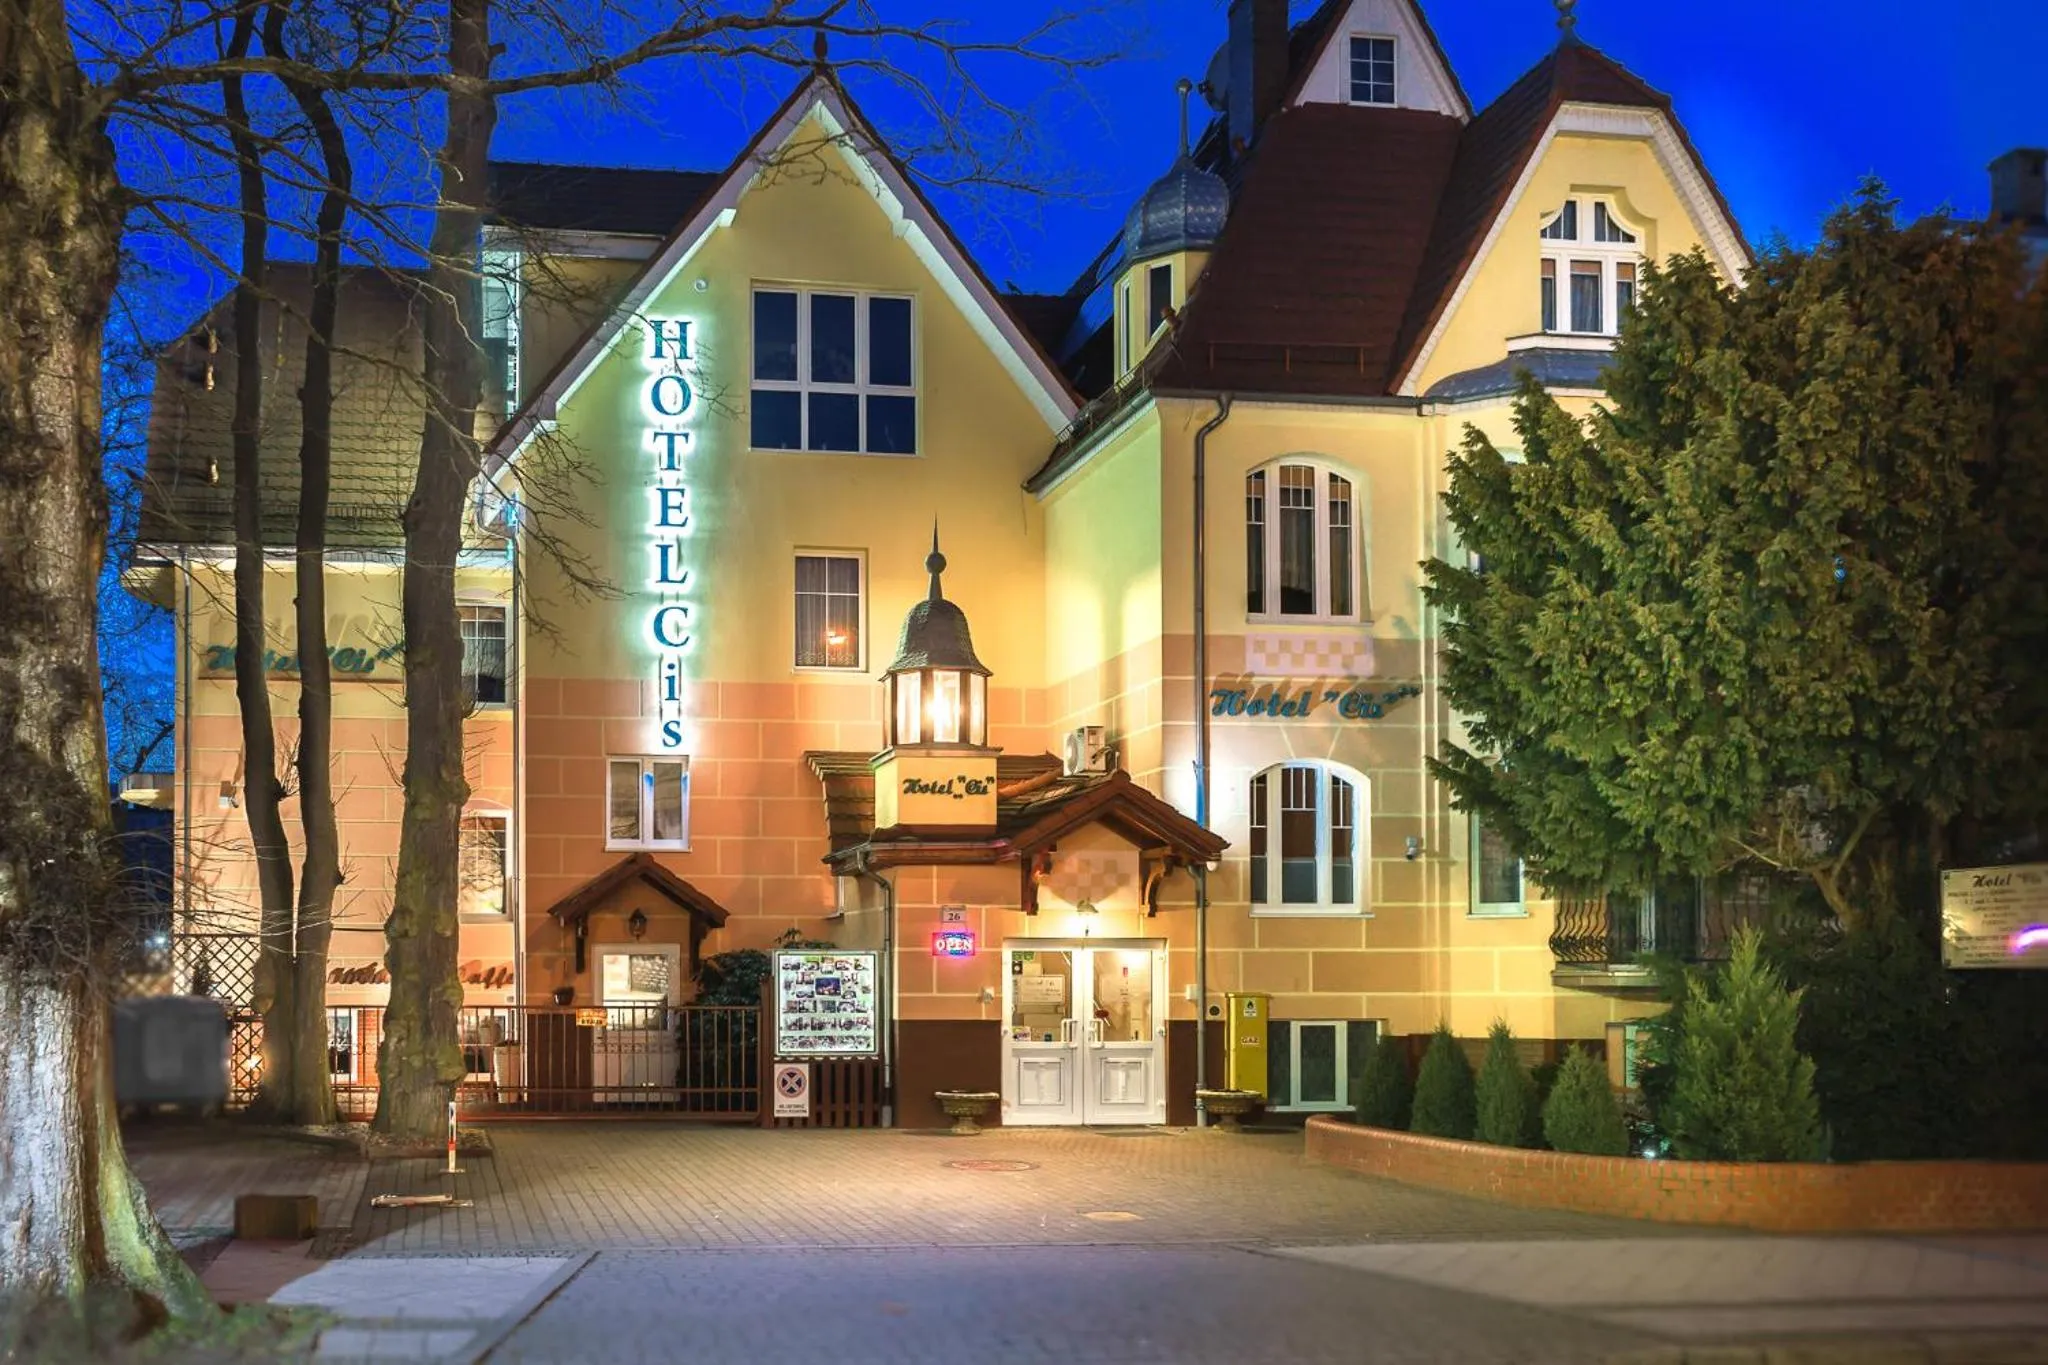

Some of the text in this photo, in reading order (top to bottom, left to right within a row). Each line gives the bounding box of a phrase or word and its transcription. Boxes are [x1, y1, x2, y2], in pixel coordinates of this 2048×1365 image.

[648, 319, 693, 748] HOTEL Cis
[1210, 687, 1313, 718] Hotel
[902, 778, 954, 795] Hotel
[1972, 872, 2012, 887] Hotel
[948, 912, 961, 921] 26
[936, 938, 973, 951] OPEN
